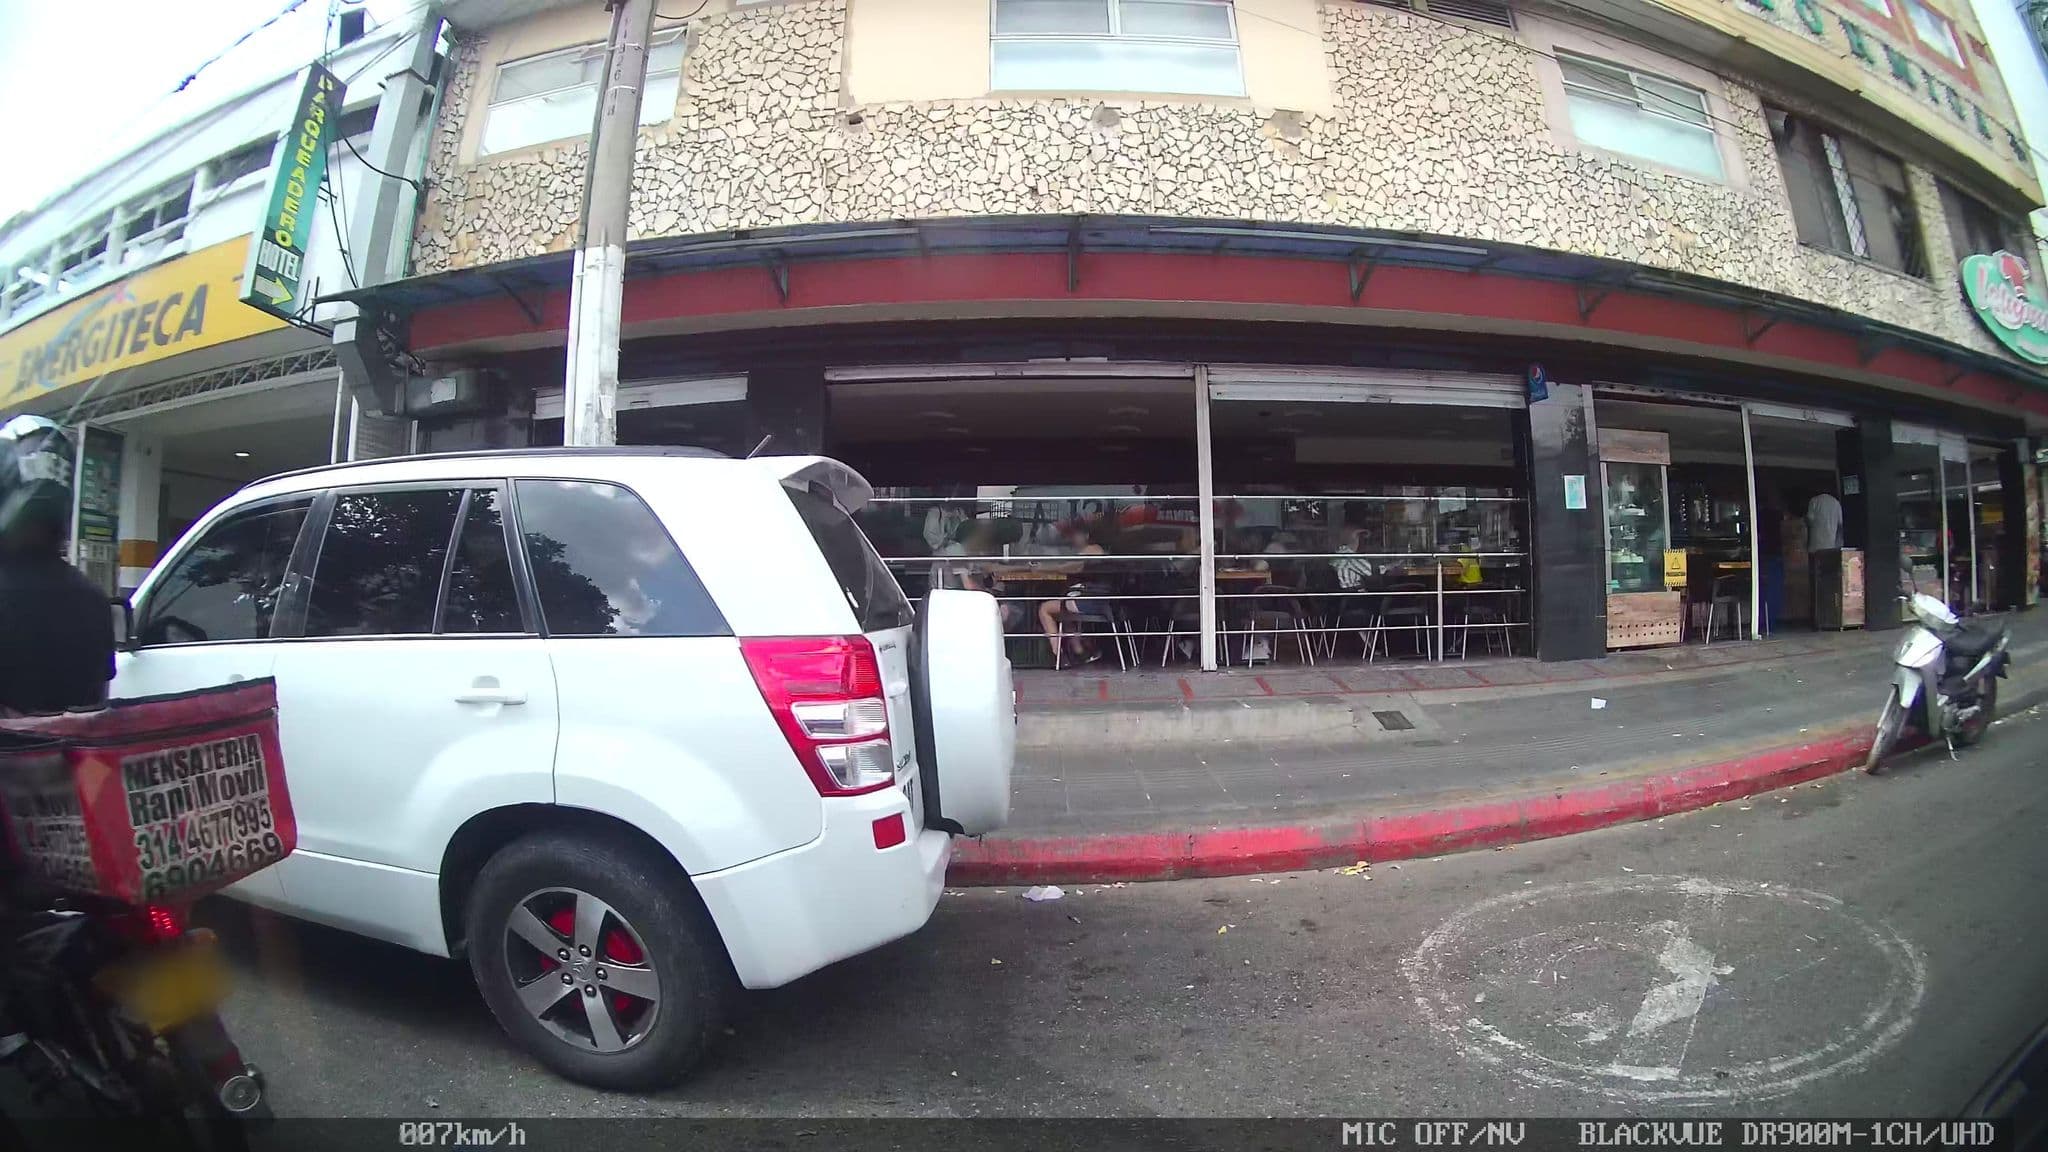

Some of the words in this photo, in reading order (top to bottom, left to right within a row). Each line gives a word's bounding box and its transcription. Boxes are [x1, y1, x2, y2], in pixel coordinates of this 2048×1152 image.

[275, 74, 334, 248] PARQUEADERO
[258, 238, 301, 283] HOTEL
[12, 284, 209, 394] ENERGITECA
[124, 734, 260, 791] MENSAJERIA
[195, 761, 266, 808] Movil
[145, 832, 283, 900] 6904669
